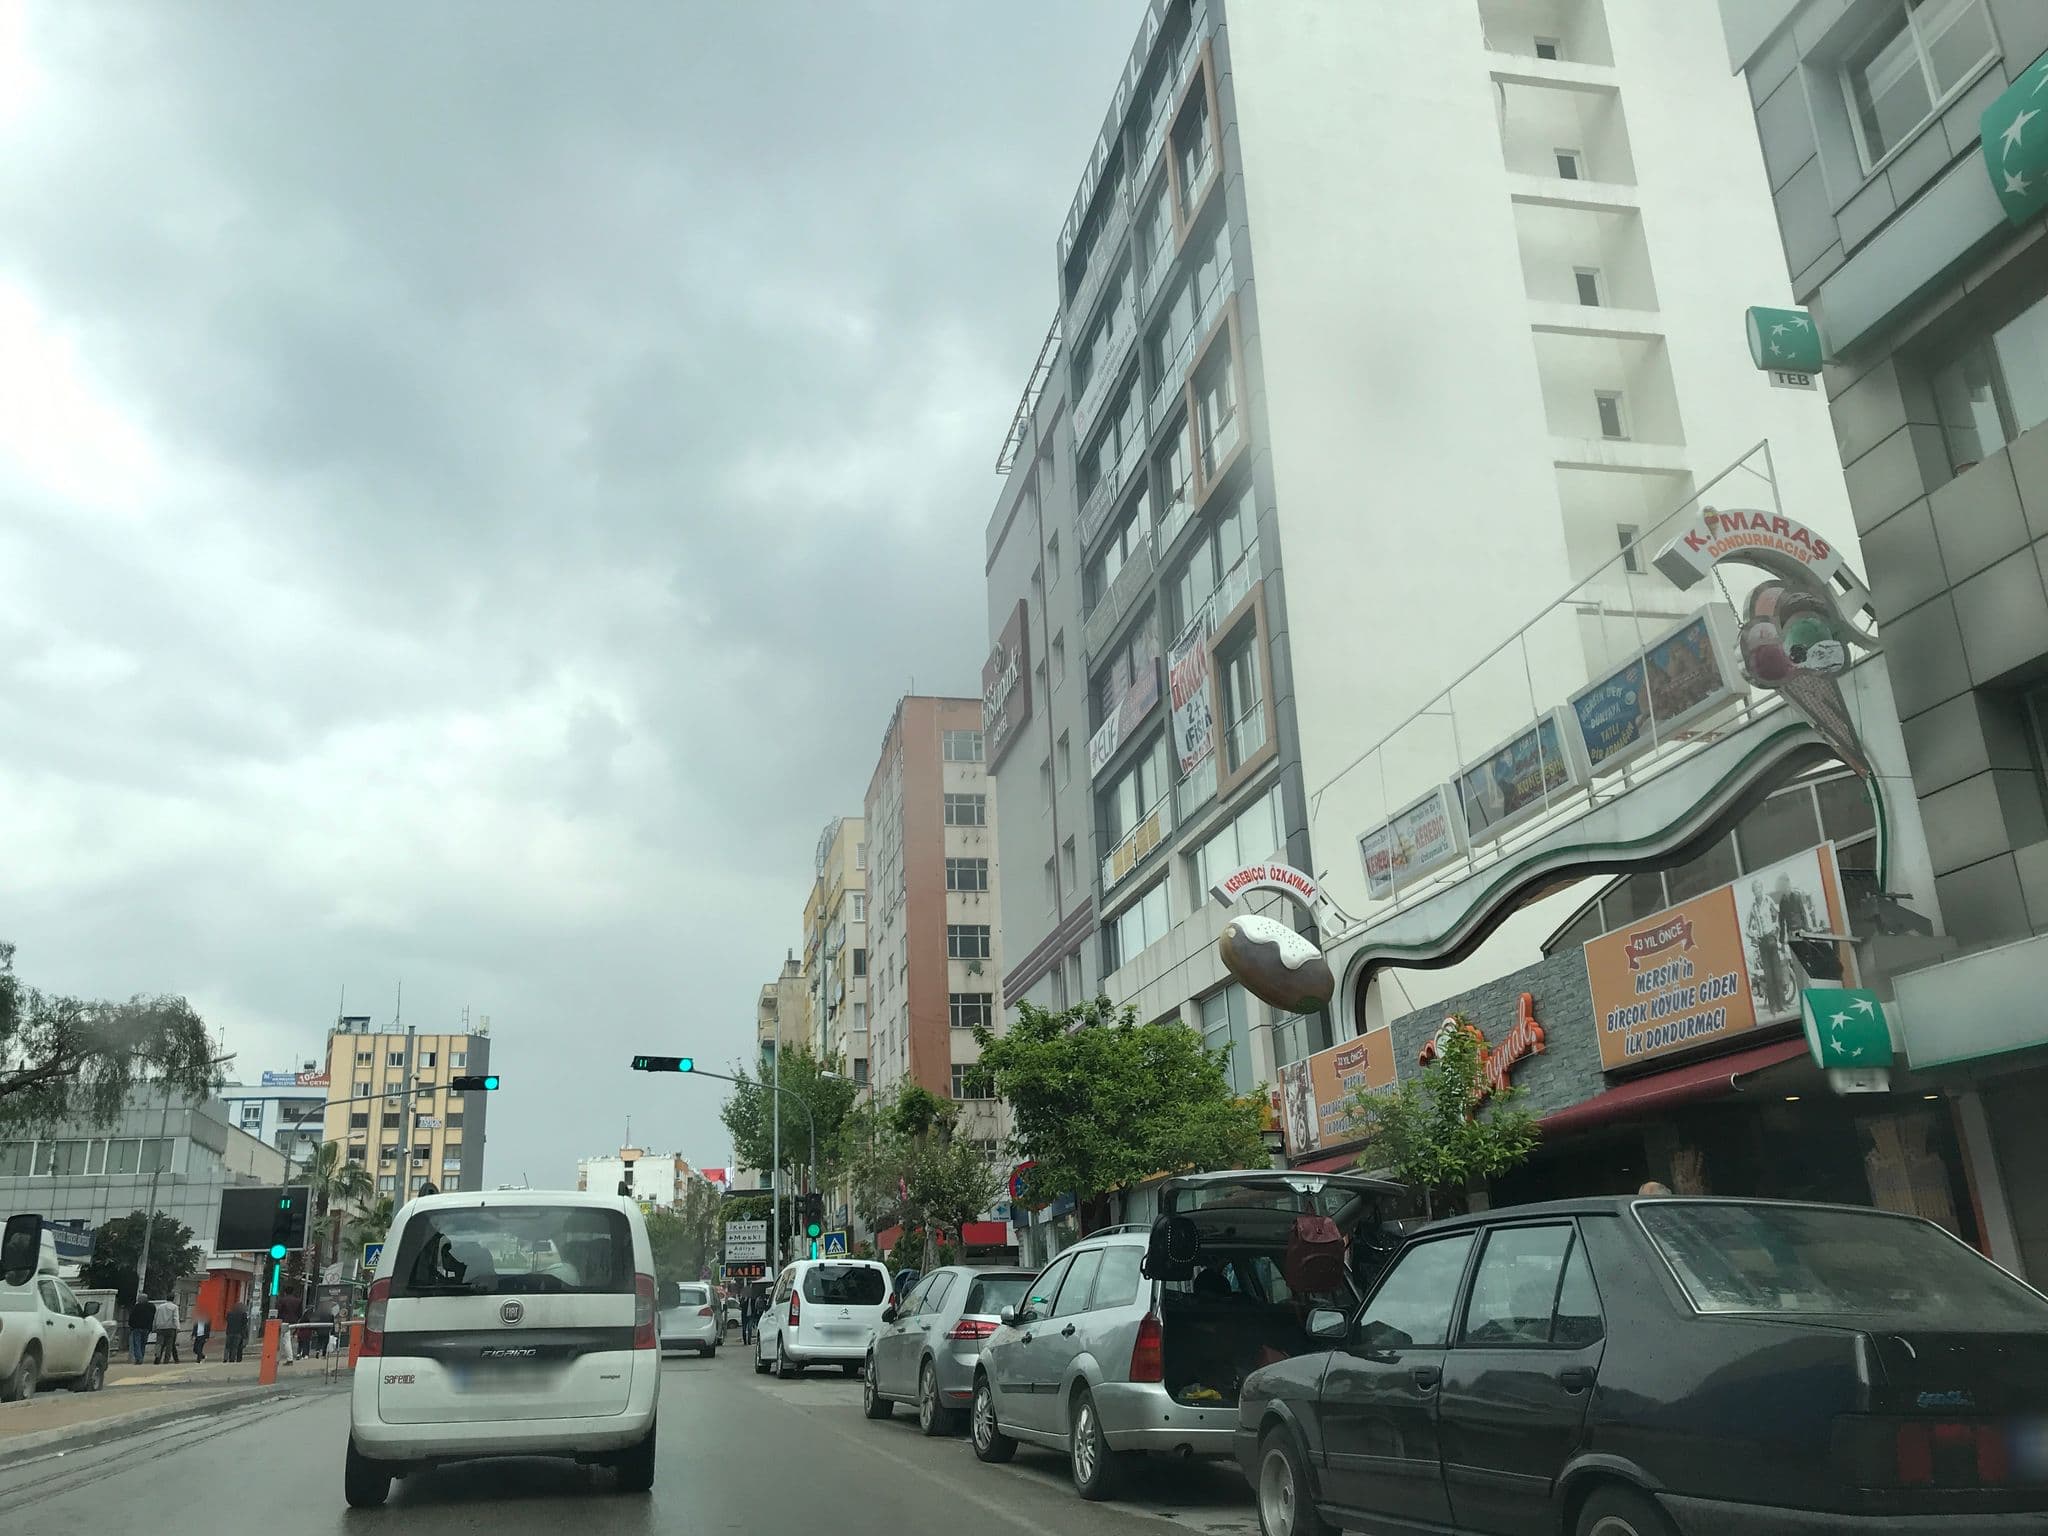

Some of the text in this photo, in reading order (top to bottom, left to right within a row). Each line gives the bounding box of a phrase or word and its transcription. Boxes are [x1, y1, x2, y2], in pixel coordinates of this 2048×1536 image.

[1115, 0, 1171, 128] PLA
[1774, 371, 1811, 386] TEB
[1270, 864, 1316, 898] ÖZKAYMAK
[1633, 922, 1684, 952] 43 YIL ÖNCE
[1606, 972, 1739, 1034] BİRÇOK KÖYÜNE GİDEN
[1624, 1008, 1727, 1058] İLK DONDURMACI
[505, 1307, 520, 1318] FIAT
[481, 1348, 537, 1359] FIORINO
